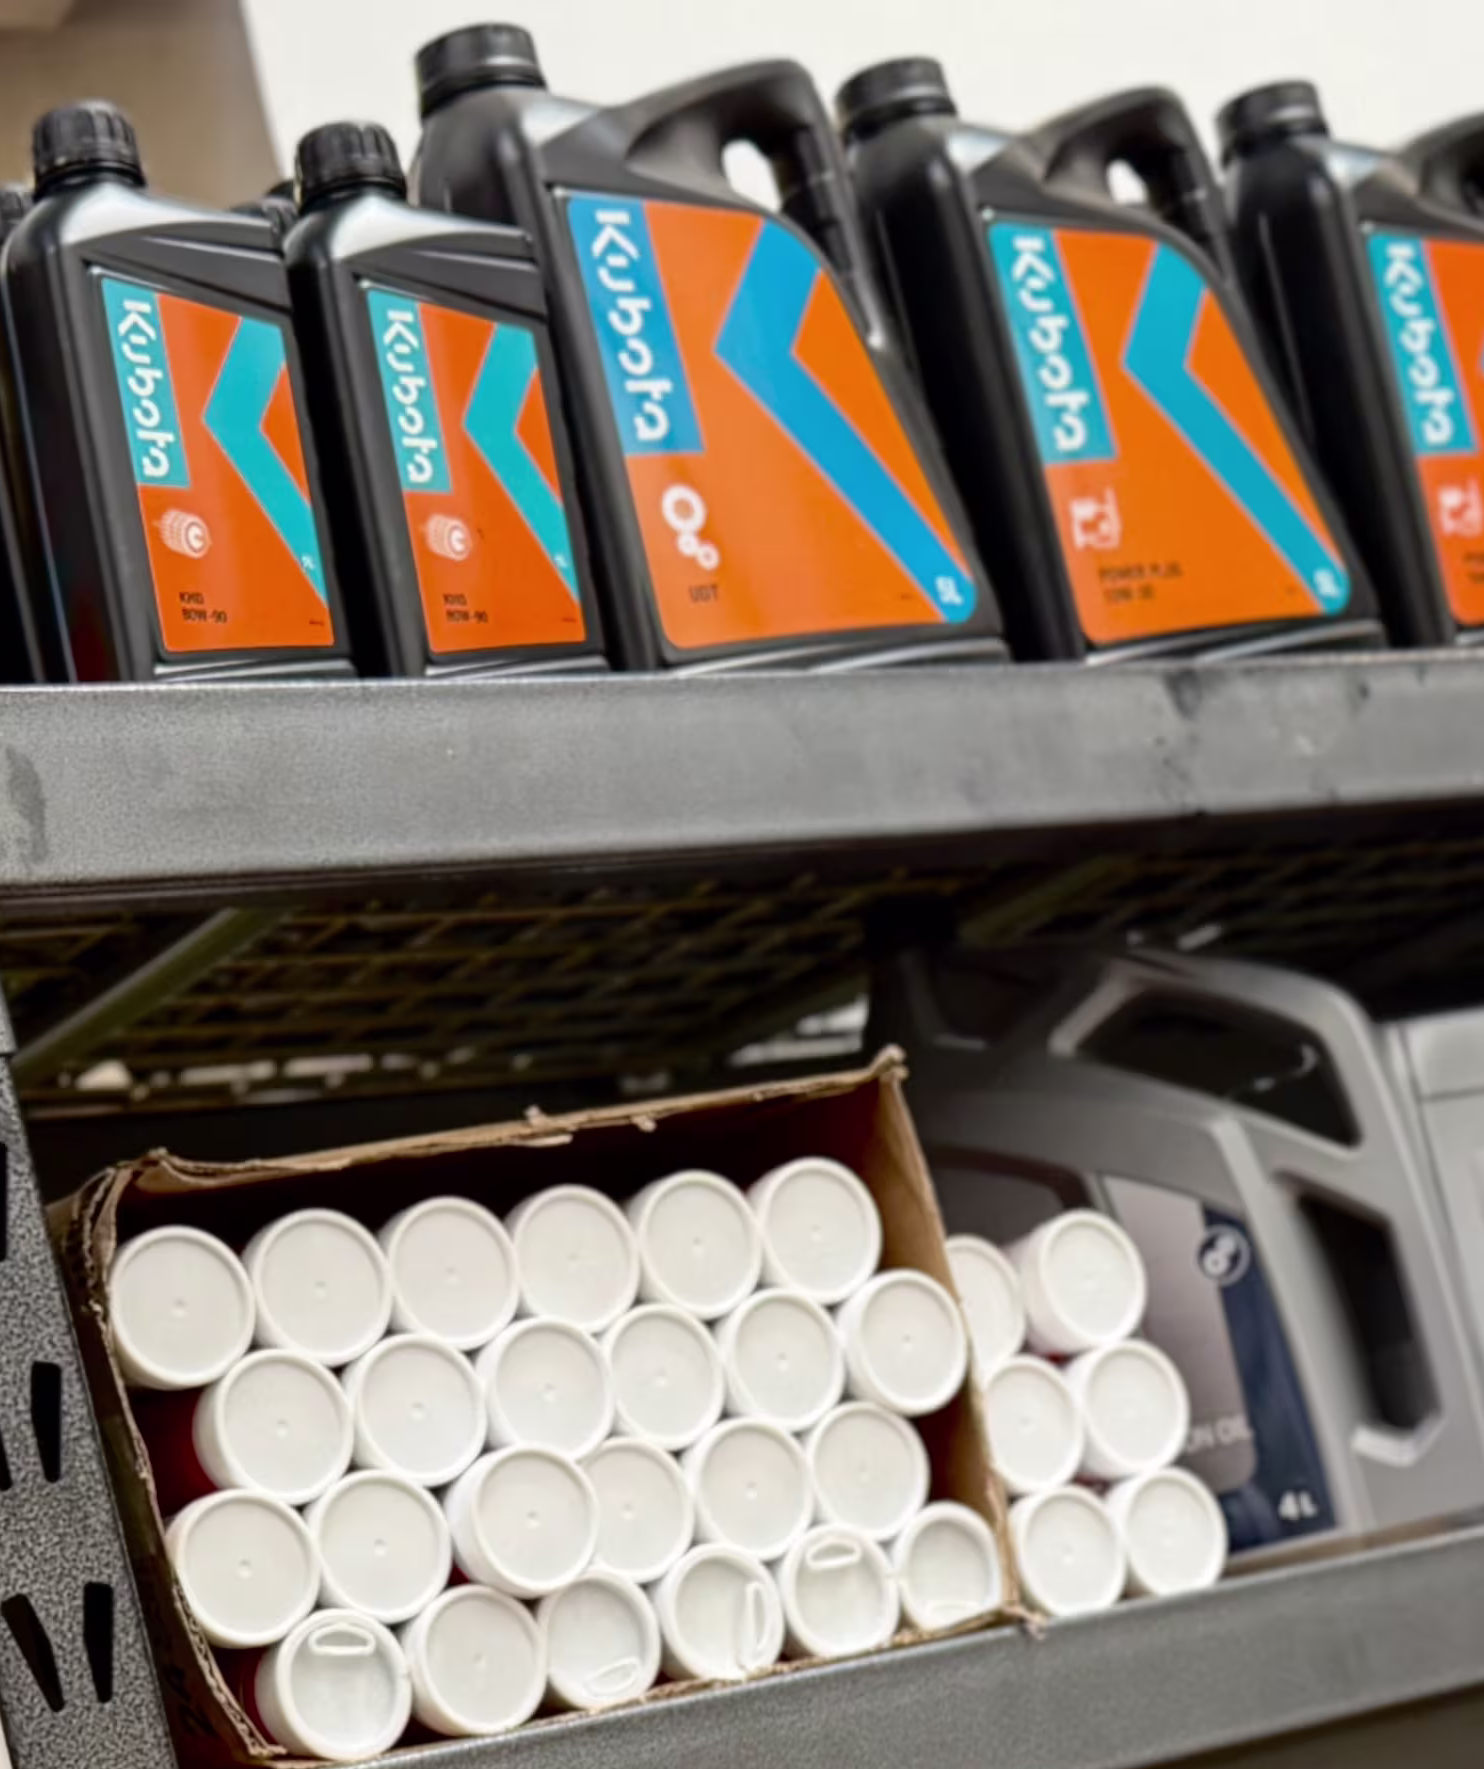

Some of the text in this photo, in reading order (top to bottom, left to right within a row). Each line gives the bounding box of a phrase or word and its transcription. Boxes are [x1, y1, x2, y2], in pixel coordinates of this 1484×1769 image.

[119, 299, 174, 480] Kubota
[383, 309, 438, 484] Kubota
[593, 210, 673, 442] Kubota
[1011, 235, 1090, 452] Kubota
[1383, 242, 1455, 447] Kubota
